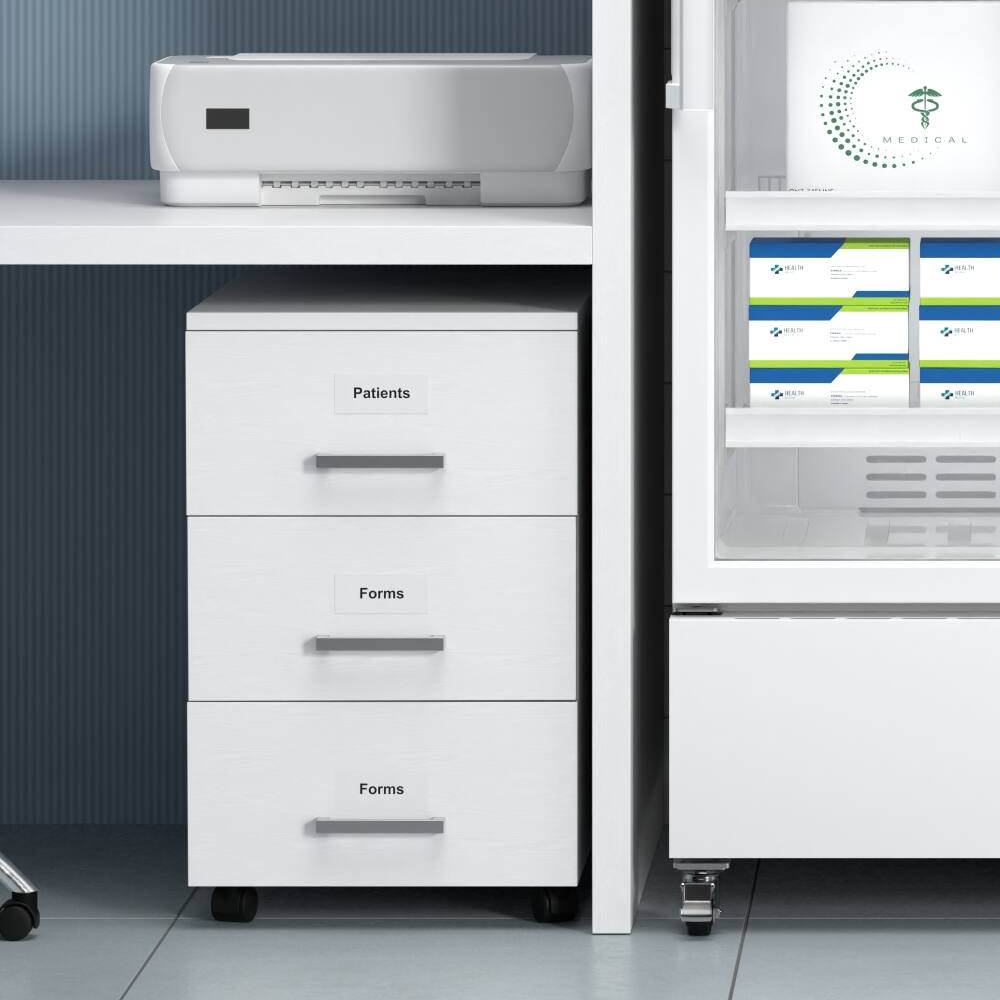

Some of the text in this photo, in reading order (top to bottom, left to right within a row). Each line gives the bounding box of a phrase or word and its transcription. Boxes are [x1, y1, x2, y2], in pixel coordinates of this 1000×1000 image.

[354, 387, 410, 398] Patients
[360, 588, 404, 599] Forms
[360, 783, 404, 794] Forms
